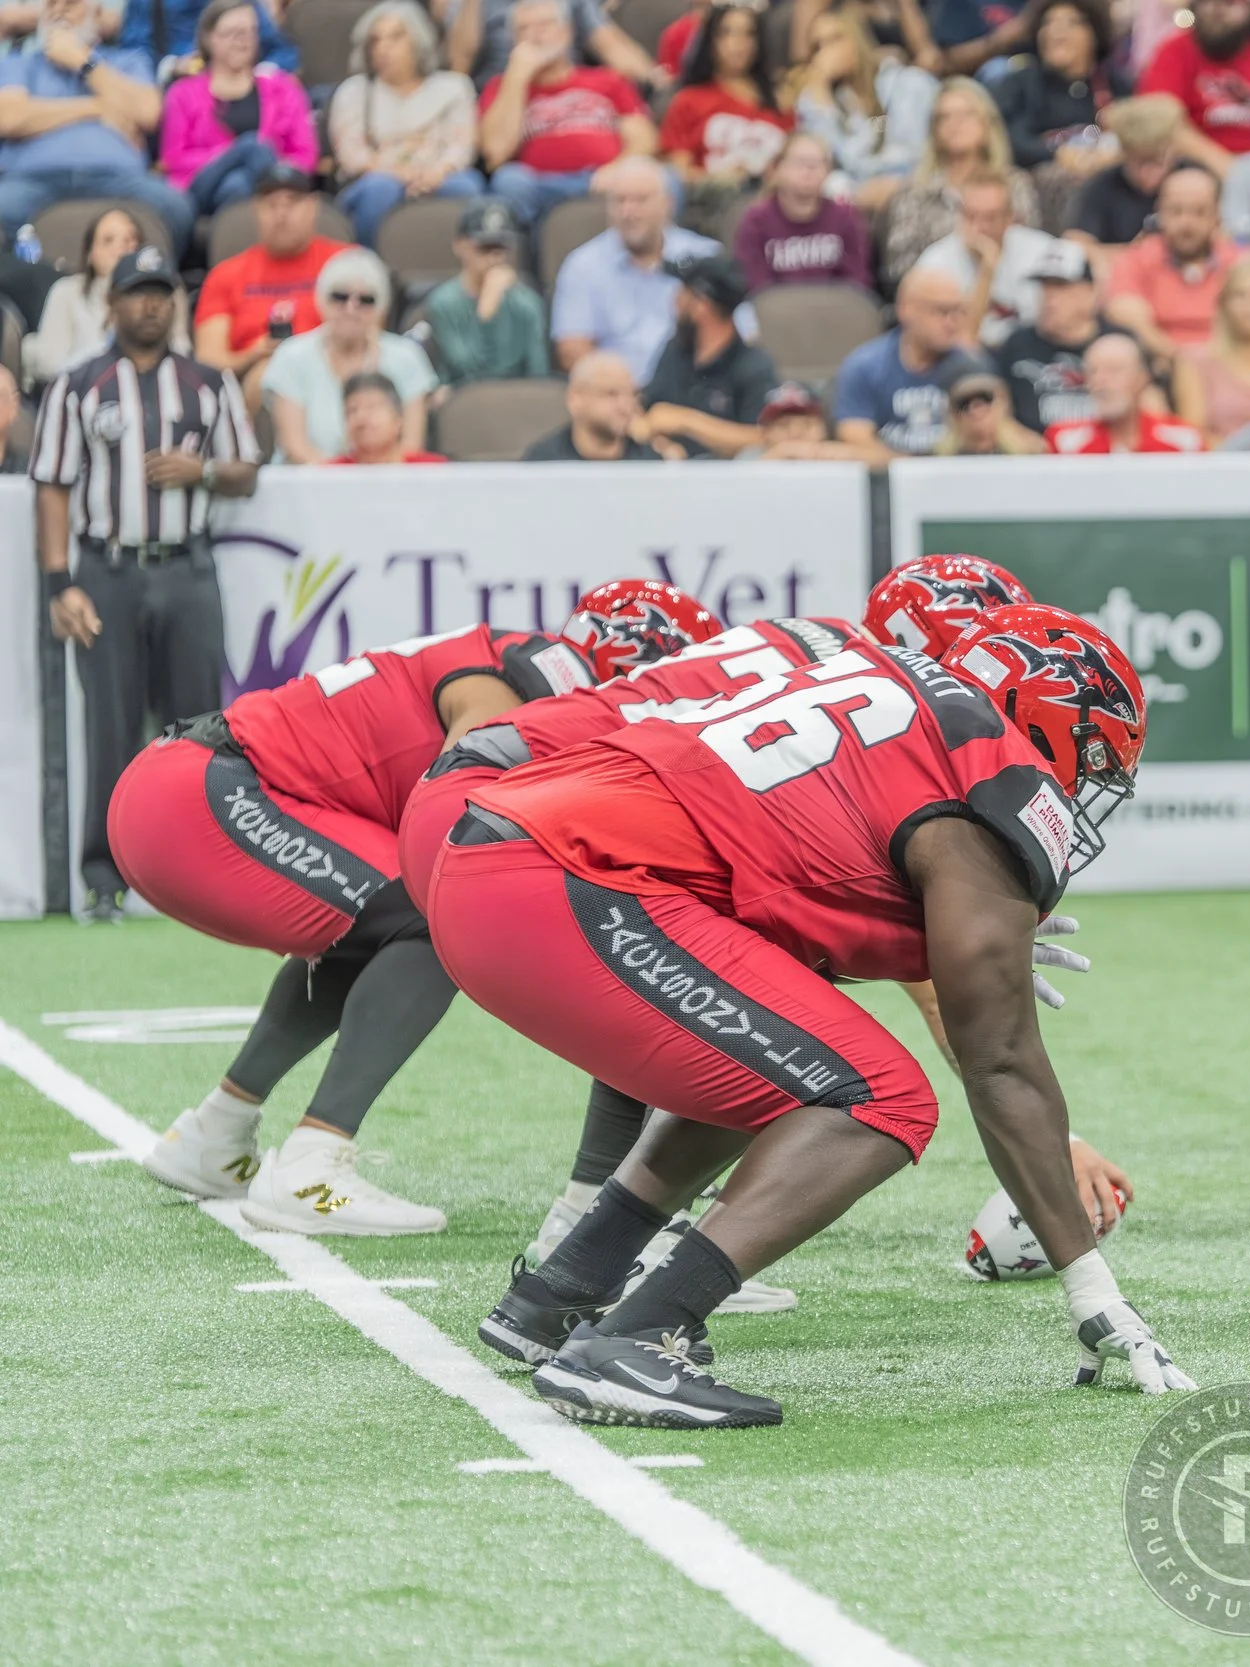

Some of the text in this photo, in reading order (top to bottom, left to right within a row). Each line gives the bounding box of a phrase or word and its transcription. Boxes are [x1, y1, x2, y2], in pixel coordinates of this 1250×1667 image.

[224, 785, 371, 909] JACKSONVIL
[600, 906, 839, 1093] JACKSONVILLE
[1020, 1239, 1037, 1251] DES
